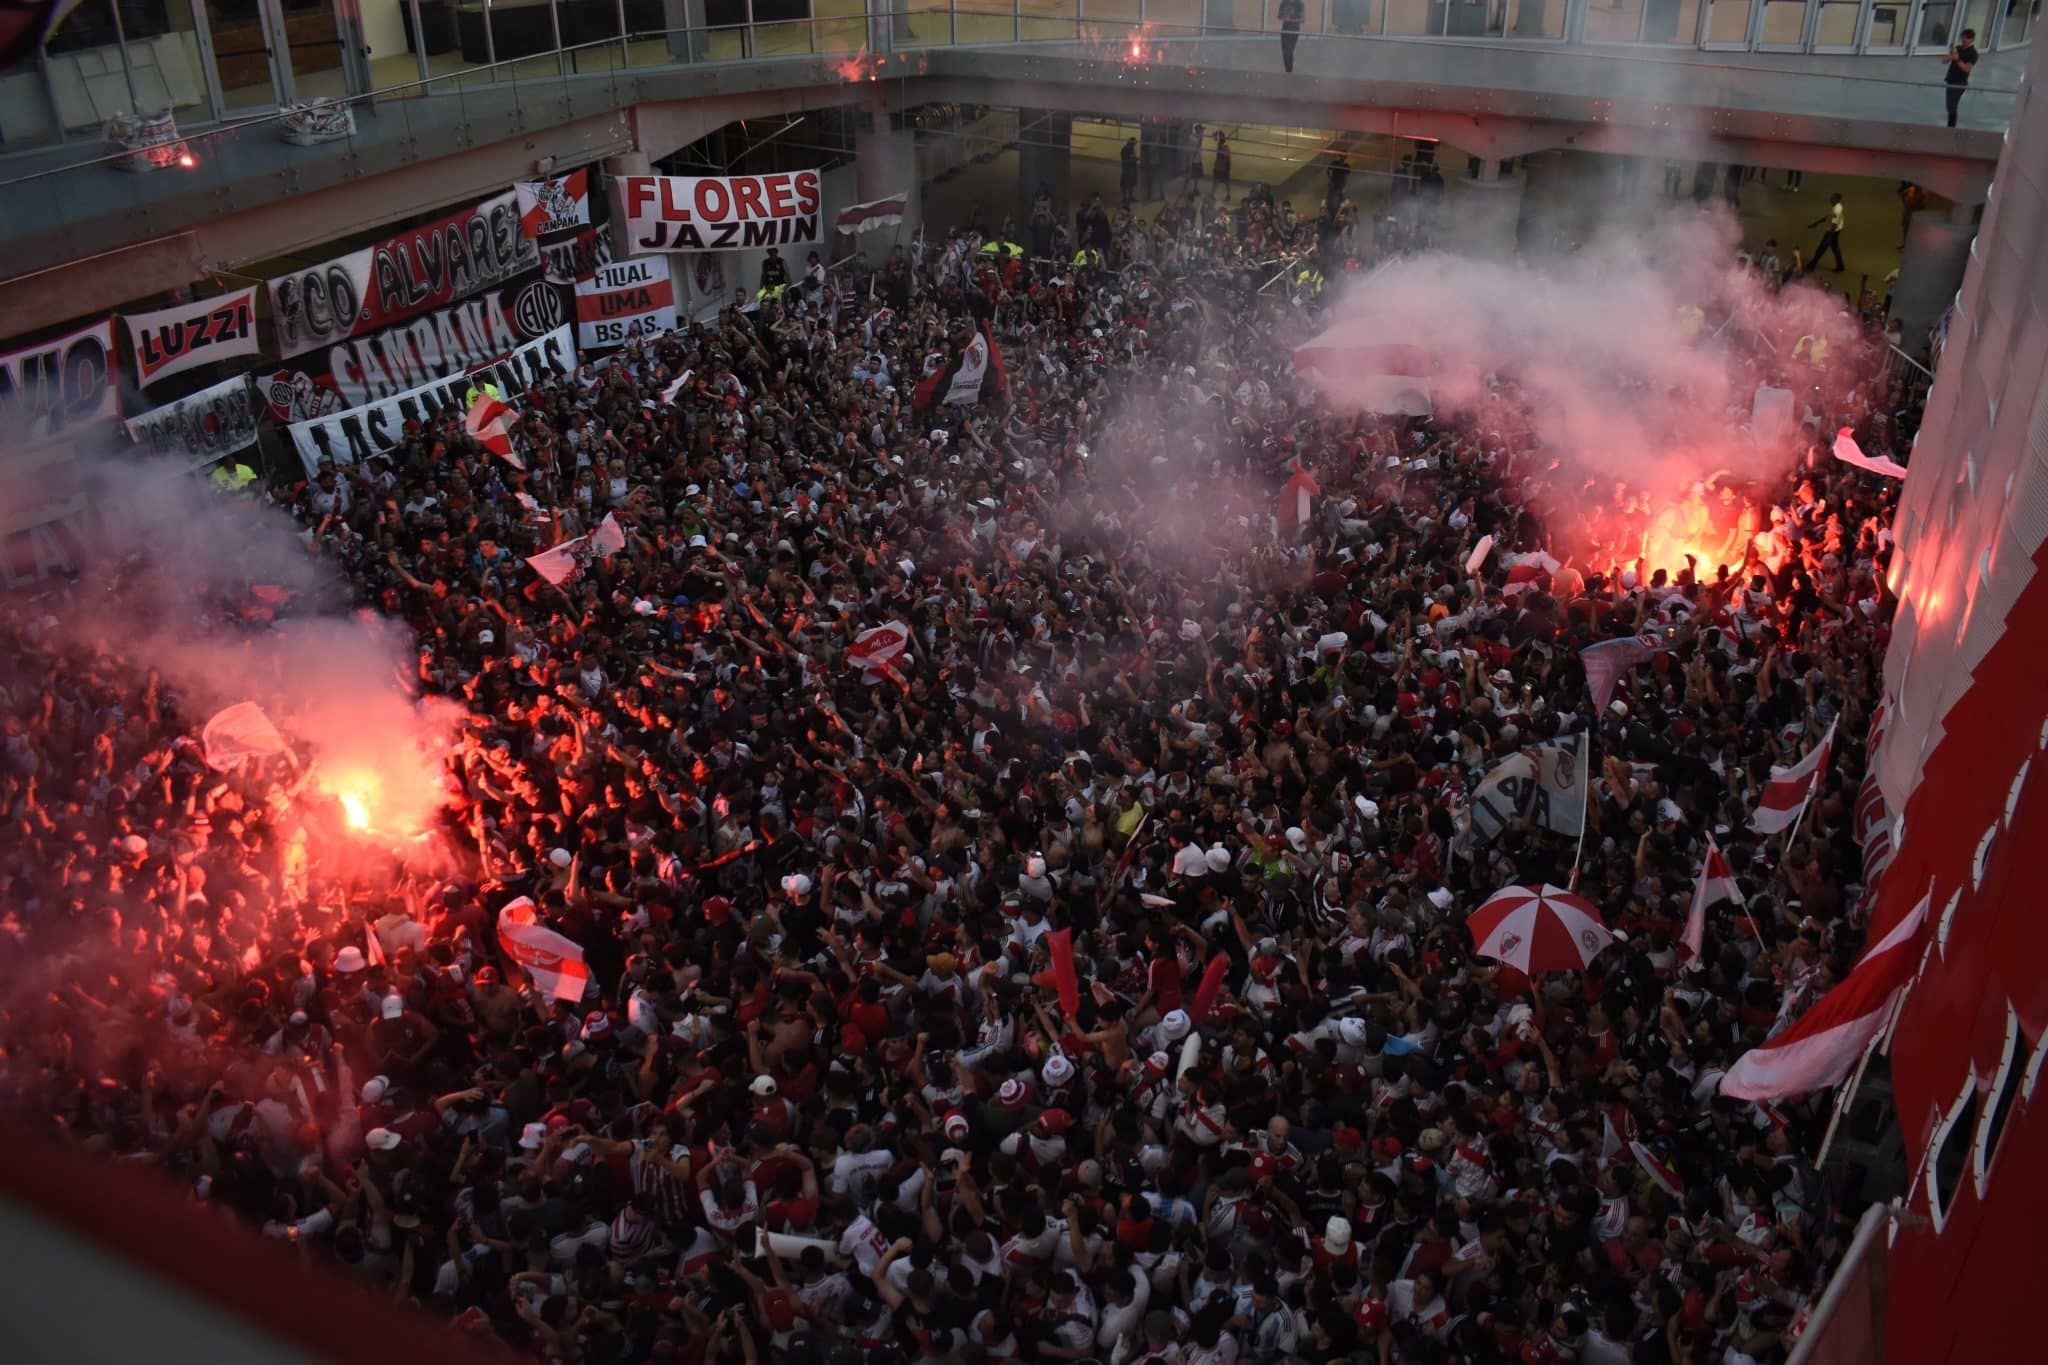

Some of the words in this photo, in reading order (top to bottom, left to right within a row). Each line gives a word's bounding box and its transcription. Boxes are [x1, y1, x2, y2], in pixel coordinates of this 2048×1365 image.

[627, 172, 820, 222] FLORES
[536, 213, 579, 234] CAMPANA
[639, 215, 818, 249] JAZMIN
[594, 264, 653, 289] FILIAL
[601, 289, 653, 316] LIMA
[141, 305, 249, 365] LUZZI
[328, 290, 519, 412] CAMPANA
[309, 408, 395, 466] LAS
